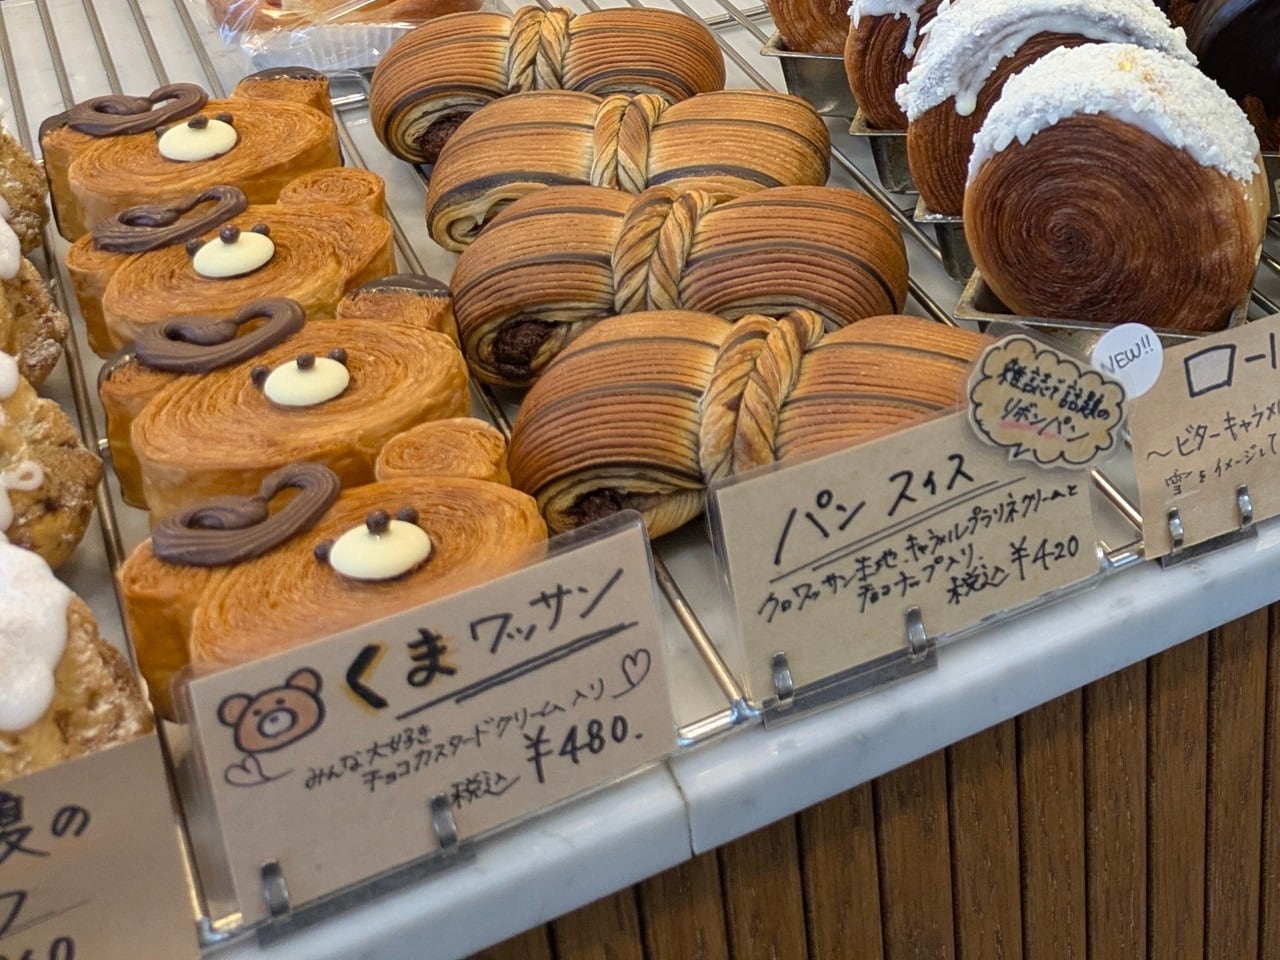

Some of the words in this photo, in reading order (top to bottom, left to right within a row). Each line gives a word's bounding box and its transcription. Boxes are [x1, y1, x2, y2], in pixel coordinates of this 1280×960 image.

[1101, 334, 1155, 376] NEW!!
[998, 356, 1110, 420] 雑誌で話題の
[1001, 396, 1090, 443] リボンパン
[947, 563, 1010, 606] 税込
[1009, 535, 1081, 581] ¥420
[303, 722, 433, 790] みんな大好き
[448, 769, 520, 810] 税込
